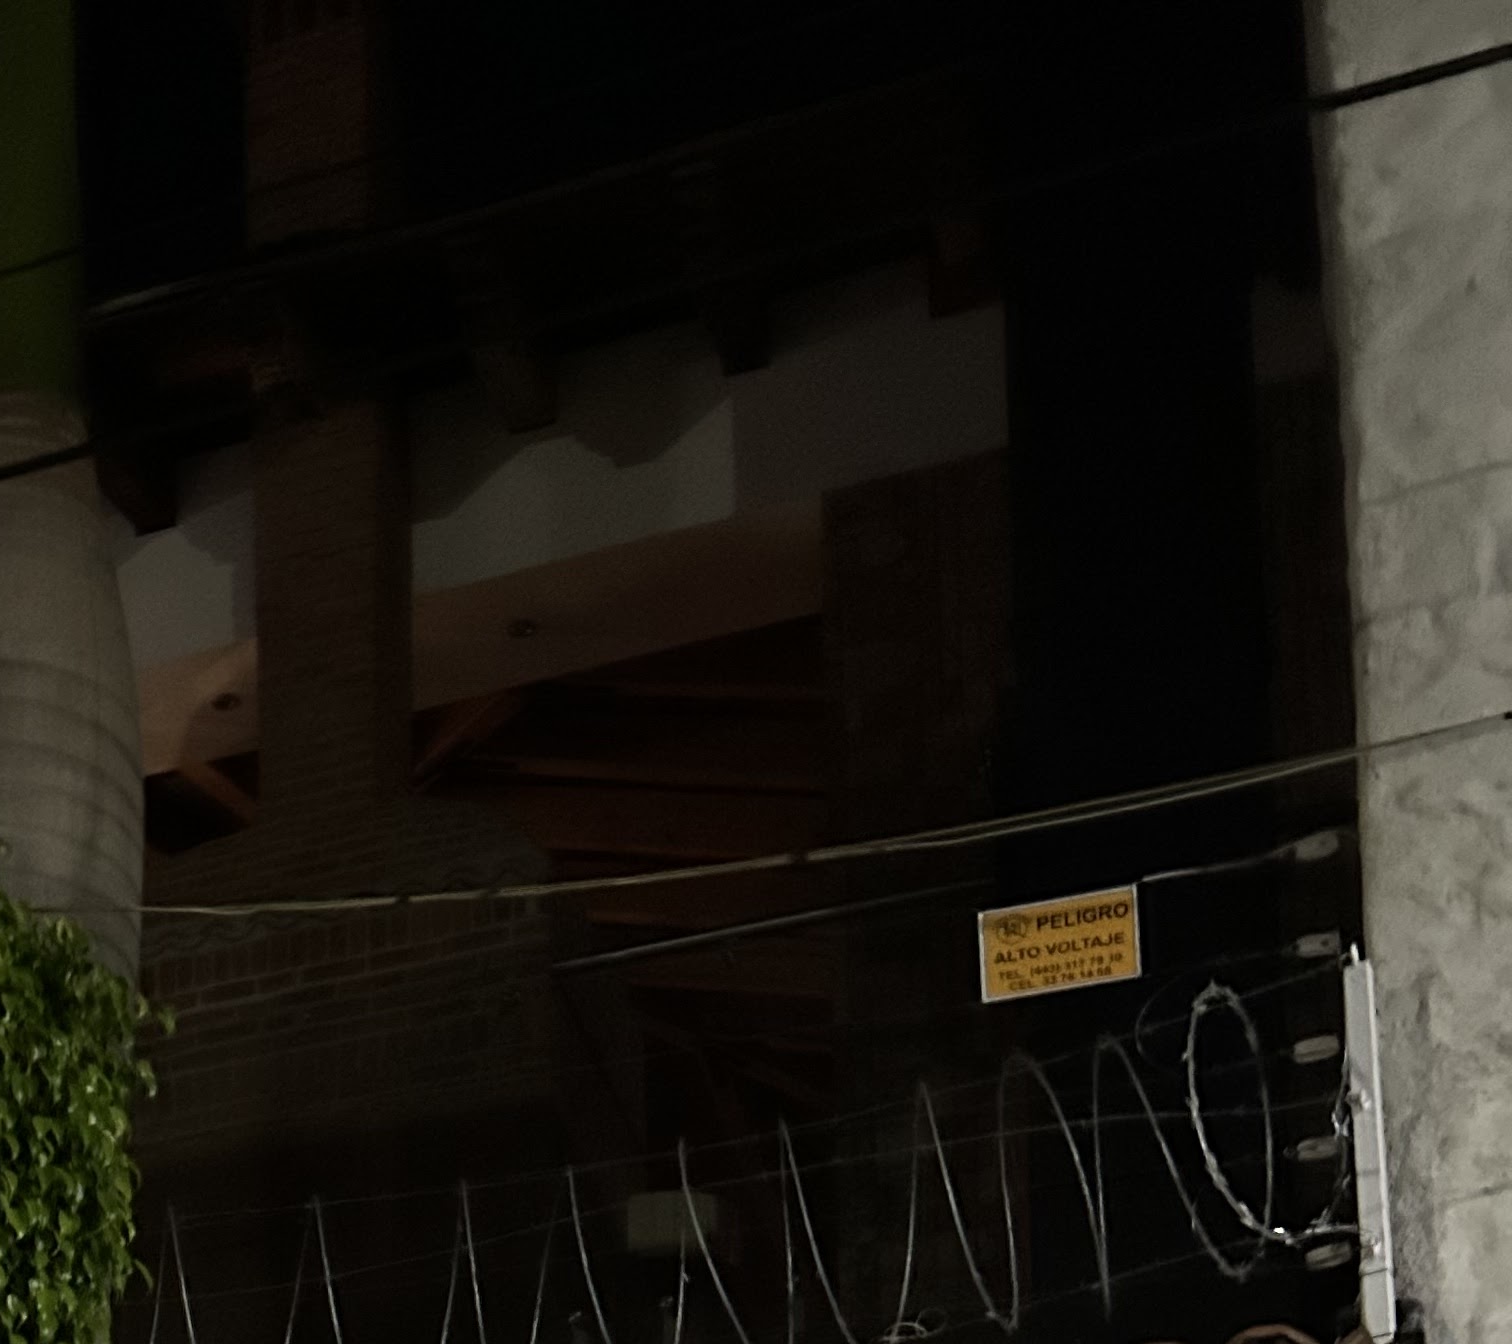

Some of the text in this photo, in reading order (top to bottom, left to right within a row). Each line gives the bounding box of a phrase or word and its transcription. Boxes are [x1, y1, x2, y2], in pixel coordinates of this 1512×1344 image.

[1036, 902, 1129, 931] PELIGRO
[994, 932, 1125, 964] ALTO VOLTAJE
